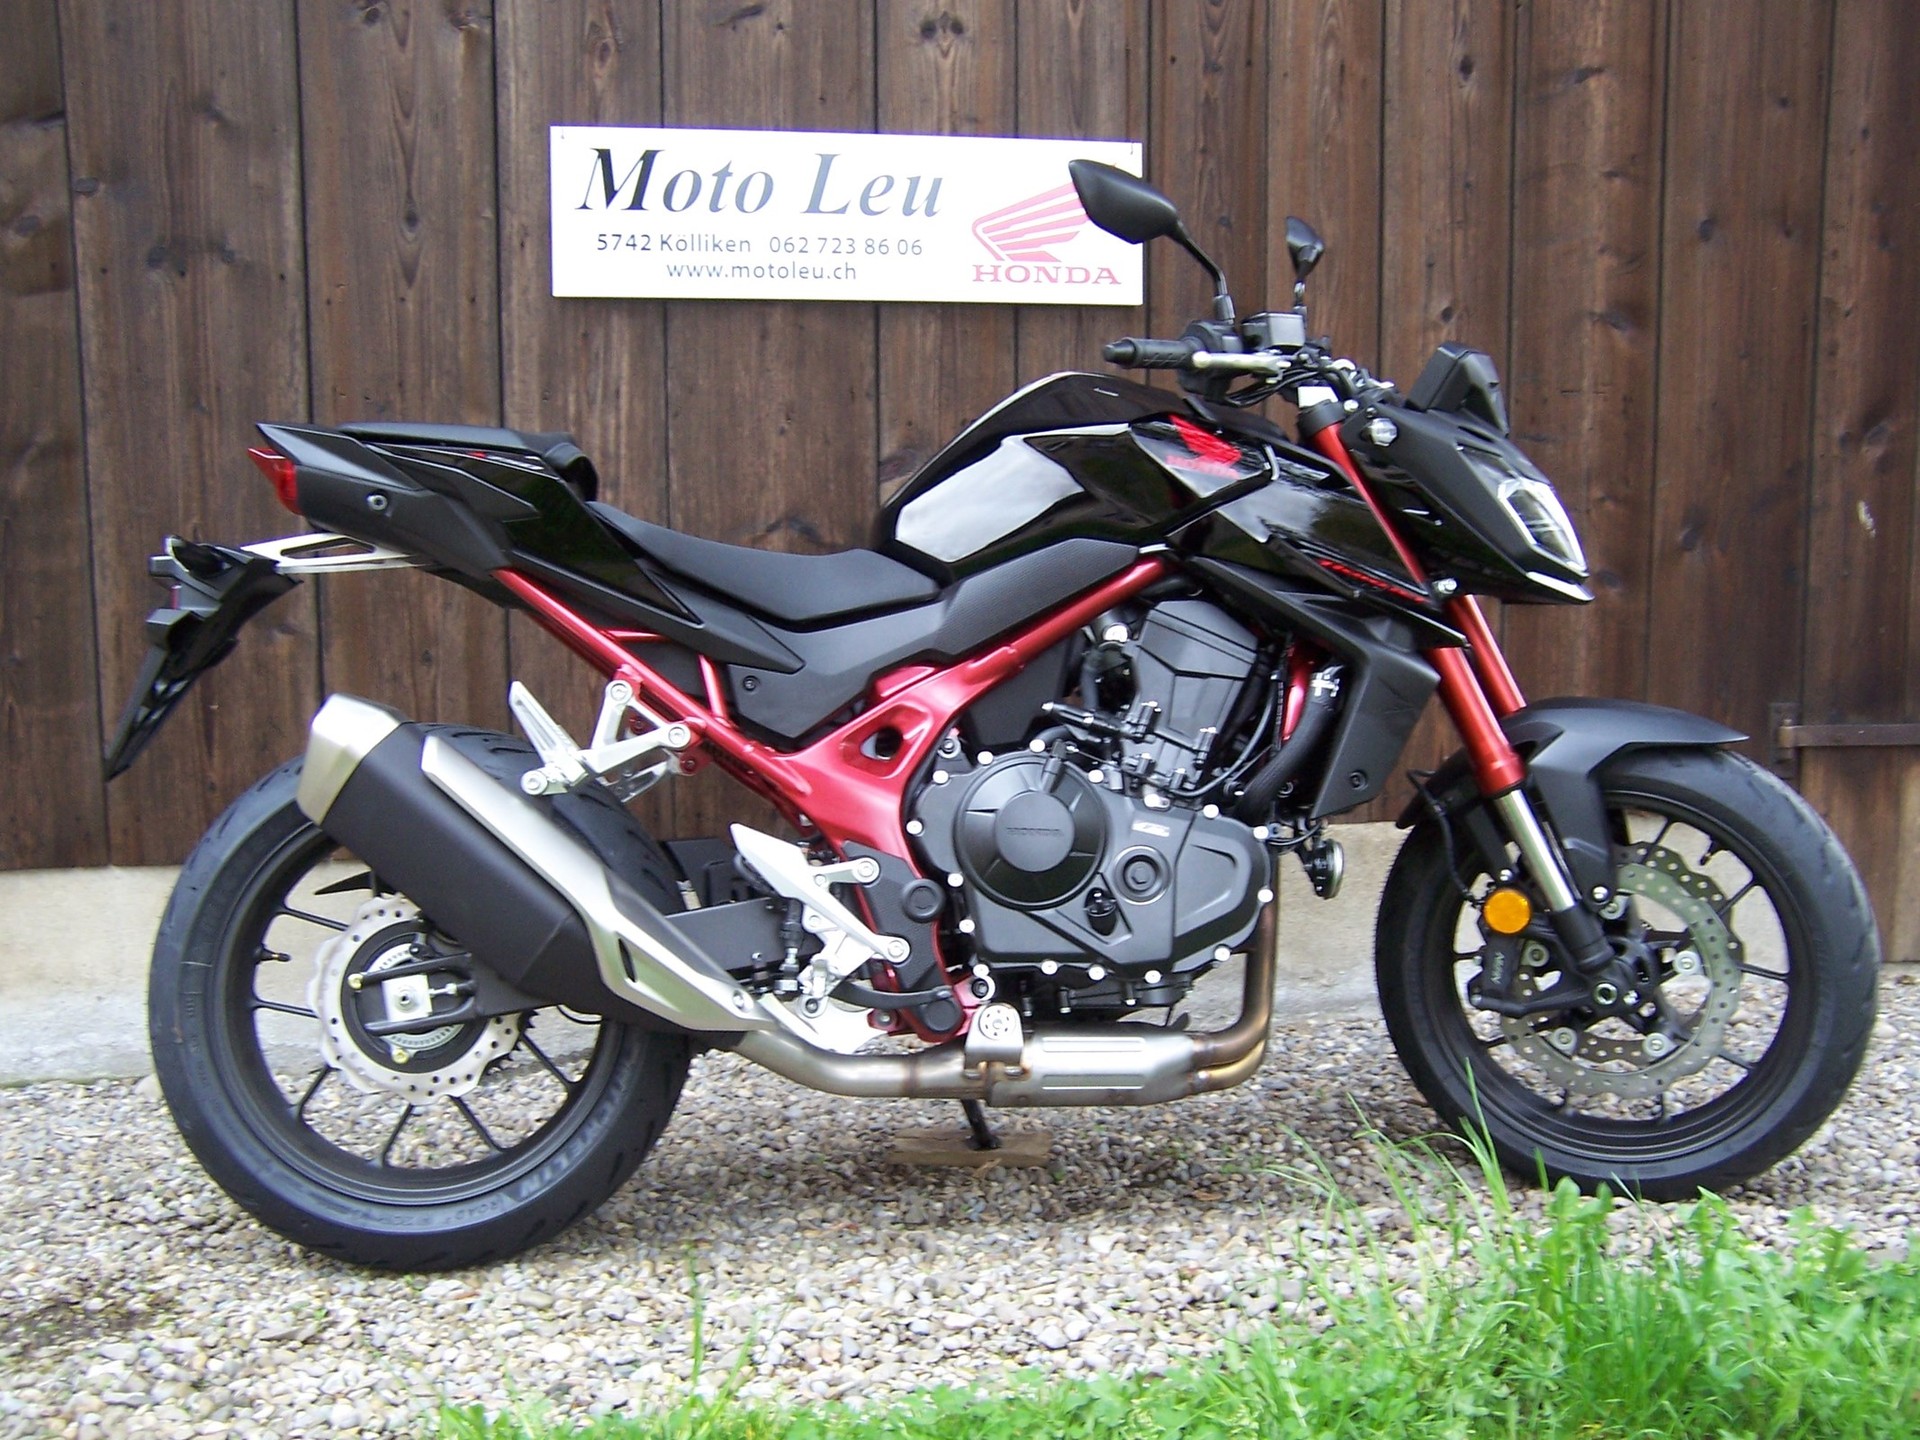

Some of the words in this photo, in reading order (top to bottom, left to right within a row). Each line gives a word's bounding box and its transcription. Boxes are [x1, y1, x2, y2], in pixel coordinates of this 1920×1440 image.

[574, 147, 774, 214] Moto
[800, 153, 943, 218] Leu
[597, 233, 652, 252] 5742
[660, 234, 752, 253] Kölliken
[769, 236, 809, 254] 062
[818, 237, 856, 255] 723
[864, 238, 890, 255] 86
[897, 239, 923, 256] 06
[666, 262, 857, 280] www.motoleu.ch
[972, 264, 1122, 286] HONDA
